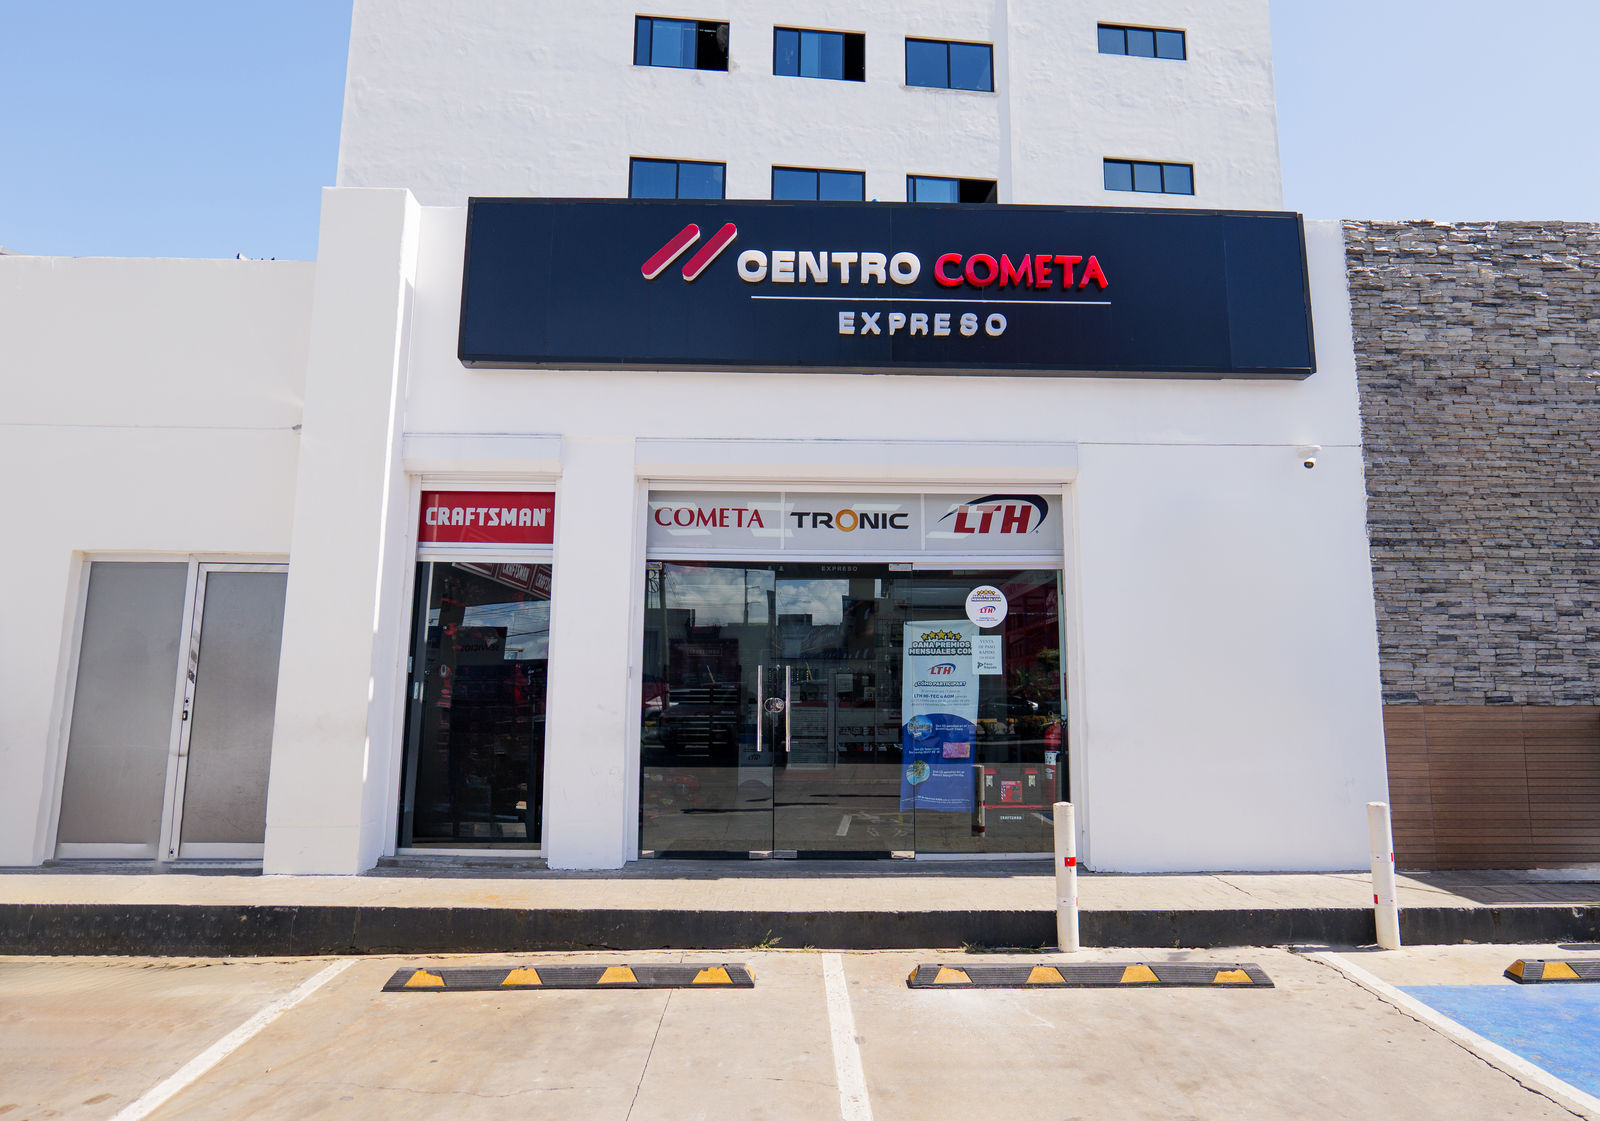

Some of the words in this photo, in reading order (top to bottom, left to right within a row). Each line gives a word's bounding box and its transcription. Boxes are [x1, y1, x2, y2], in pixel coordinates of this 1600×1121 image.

[736, 249, 922, 285] CENTRO
[933, 252, 1109, 290] COMETA
[838, 310, 1008, 337] EXPRESO
[655, 506, 764, 528] COMETA
[790, 508, 909, 533] TRONIC
[953, 504, 1032, 534] LTH
[909, 648, 957, 656] MENSUALES
[930, 666, 952, 675] LTH
